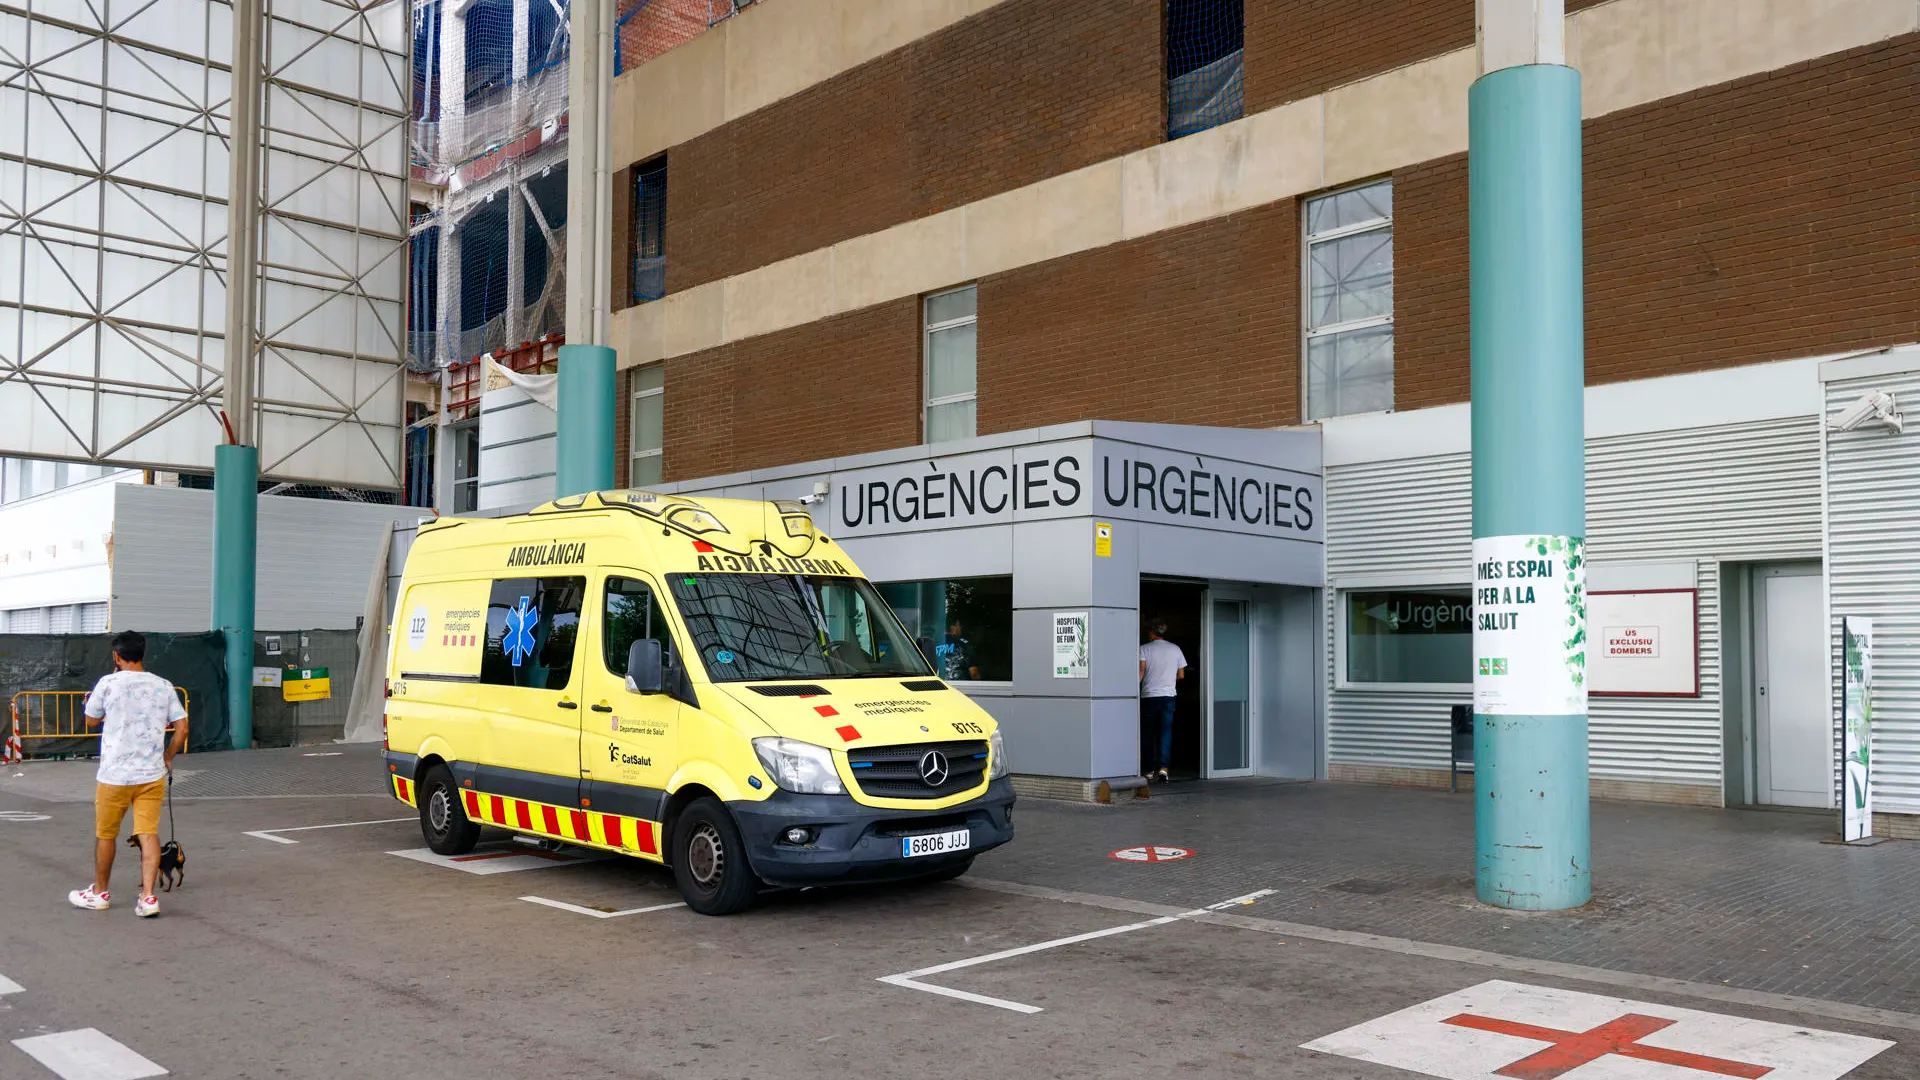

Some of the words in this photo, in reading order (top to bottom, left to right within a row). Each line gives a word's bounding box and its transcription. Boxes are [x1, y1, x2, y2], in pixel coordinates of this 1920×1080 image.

[842, 456, 1082, 528] URGÈNCIES
[1103, 456, 1313, 531] URGÈNCIES
[507, 538, 586, 567] AMBULÀNCIA
[1477, 557, 1503, 580] MÉS
[1507, 560, 1553, 579] ESPAI
[1478, 588, 1498, 605] PER
[1502, 588, 1512, 604] A
[1516, 587, 1535, 604] LA
[411, 618, 425, 633] 112
[1056, 617, 1080, 626] HOSPITAL
[1478, 613, 1518, 631] SALUT
[1056, 626, 1074, 635] LLIURE
[1056, 635, 1063, 643] DE
[1064, 635, 1076, 643] FUM
[1610, 638, 1653, 646] EXCLUSIU
[1610, 647, 1653, 655] BOMBERS
[393, 682, 407, 695] 8715
[952, 722, 983, 734] 8715
[622, 754, 651, 767] CatSalut
[913, 836, 944, 854] 6806
[948, 833, 968, 849] JJJ
